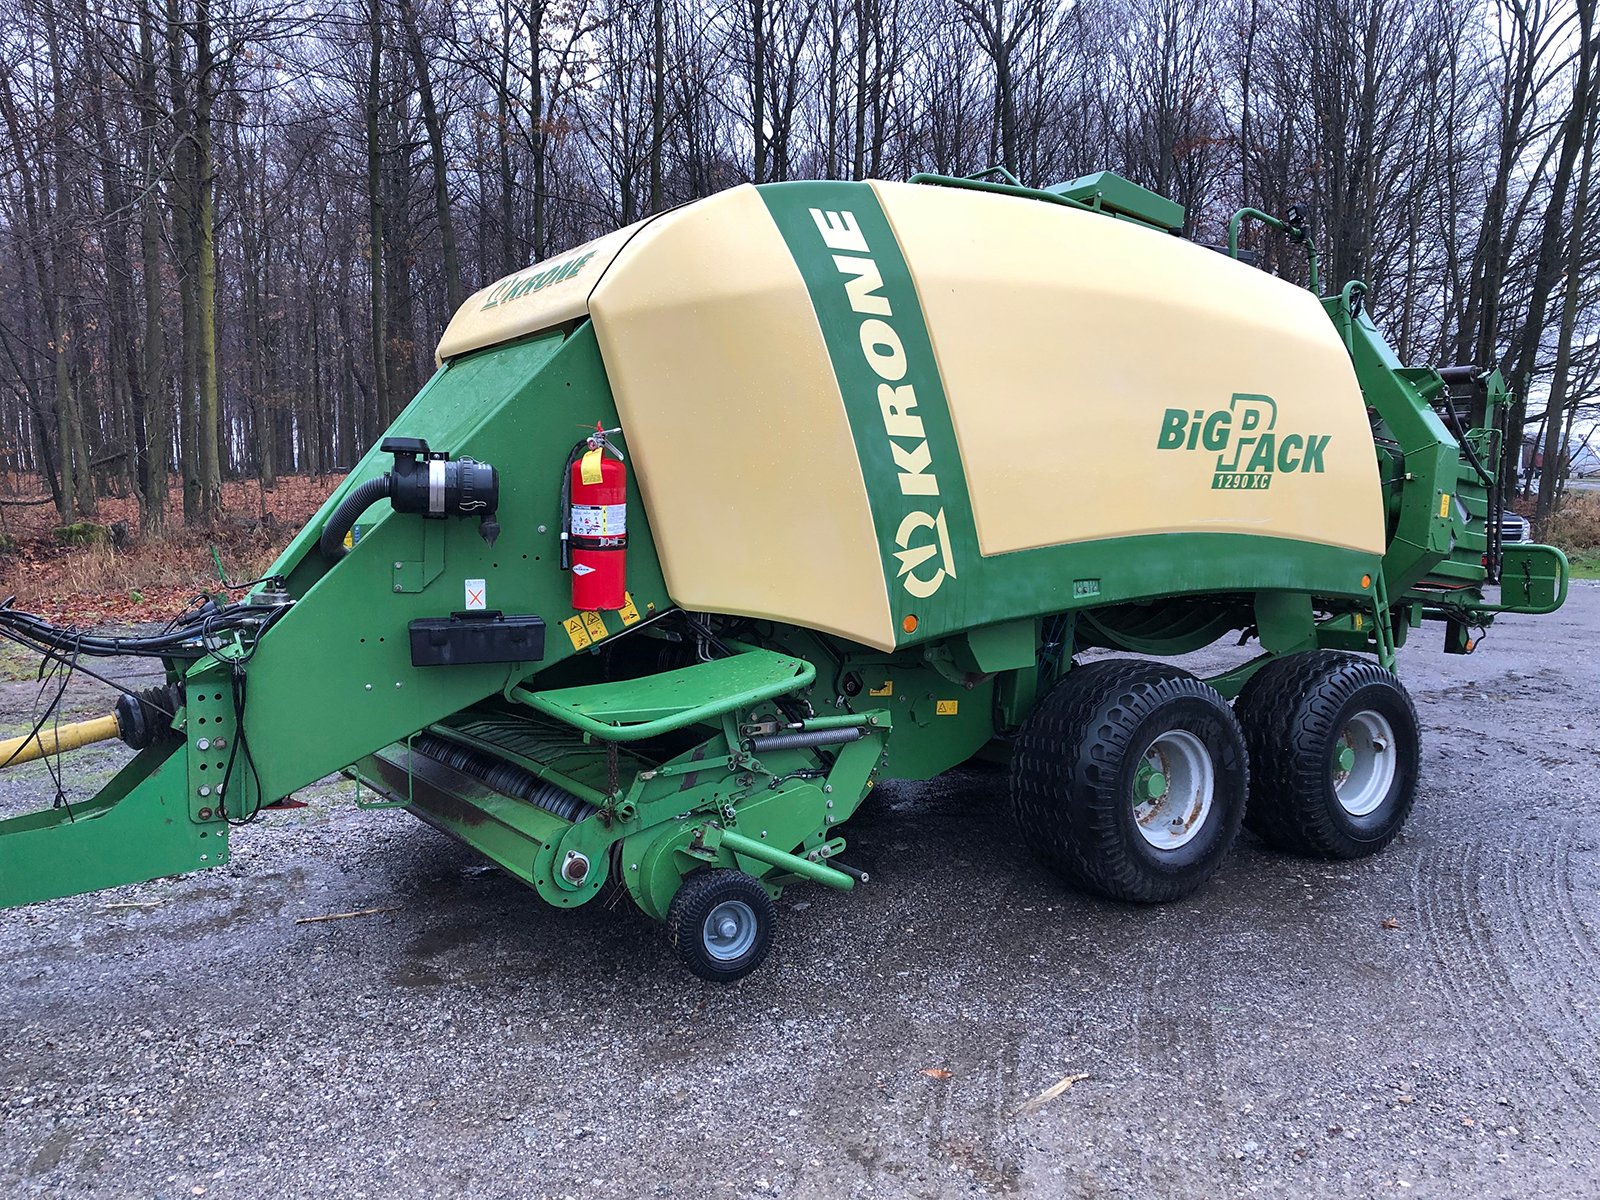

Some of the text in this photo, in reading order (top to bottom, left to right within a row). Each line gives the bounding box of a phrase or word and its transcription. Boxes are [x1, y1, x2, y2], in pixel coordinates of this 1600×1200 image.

[501, 249, 598, 304] KRONE
[809, 207, 940, 496] KRONE
[1215, 393, 1333, 473] PACK
[1217, 474, 1269, 489] 1290 XC
